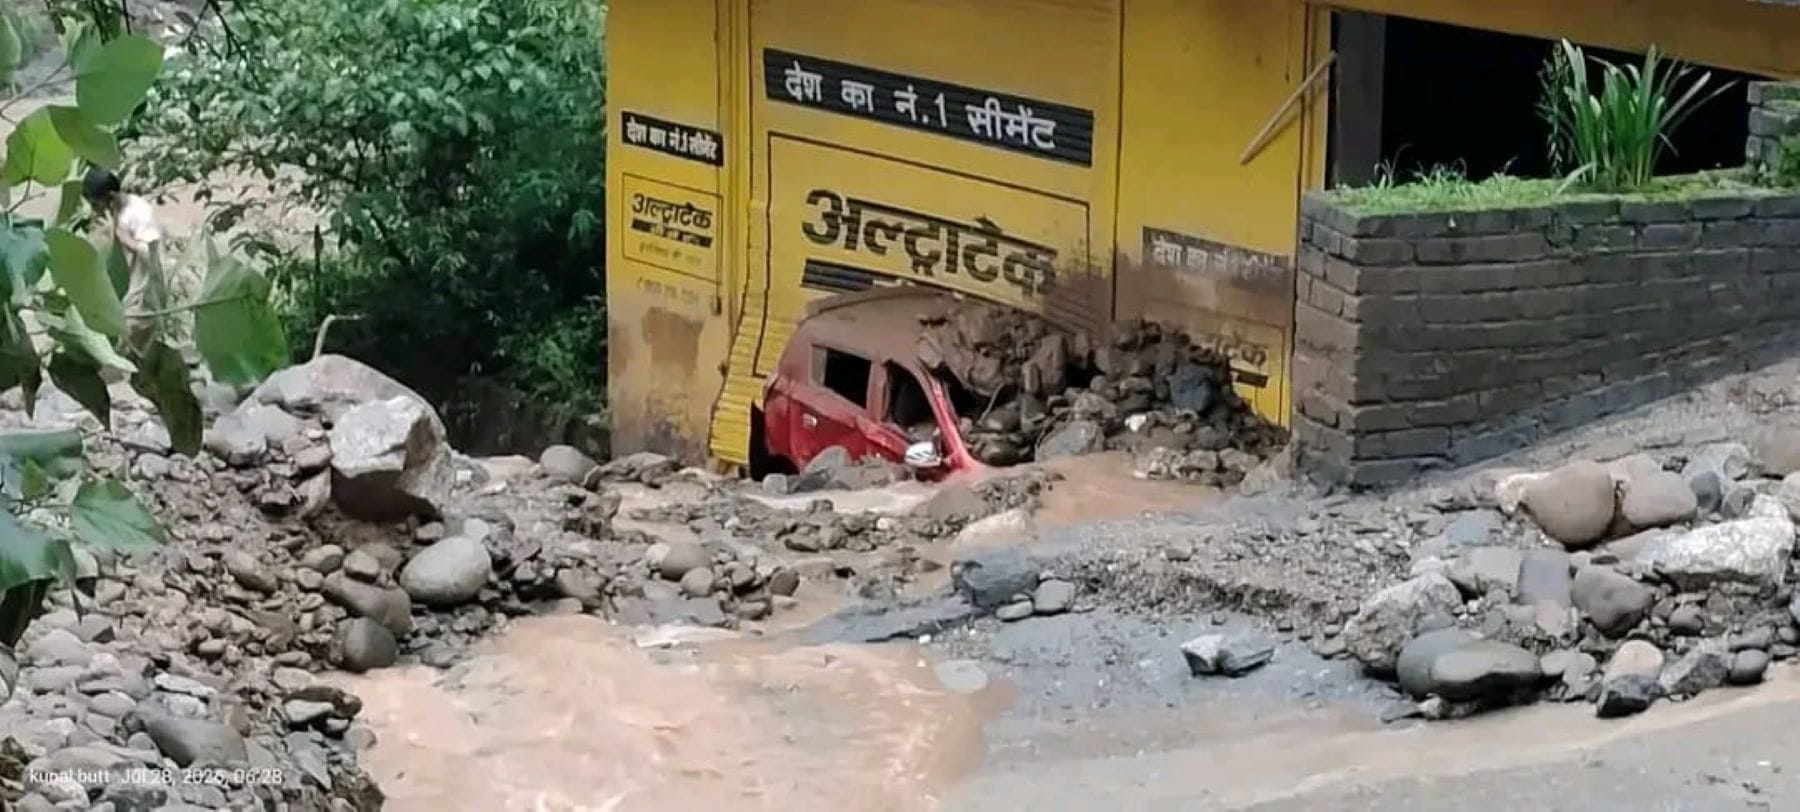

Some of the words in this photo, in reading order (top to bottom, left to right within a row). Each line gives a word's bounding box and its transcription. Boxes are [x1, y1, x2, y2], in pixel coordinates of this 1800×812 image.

[626, 116, 647, 143] देश
[649, 127, 667, 147] का
[785, 61, 823, 101] देश
[840, 79, 875, 113] का
[965, 97, 1056, 150] सीमेंट
[631, 193, 713, 229] अल्ट्राटेक
[801, 189, 1060, 296] अल्ट्राटेक
